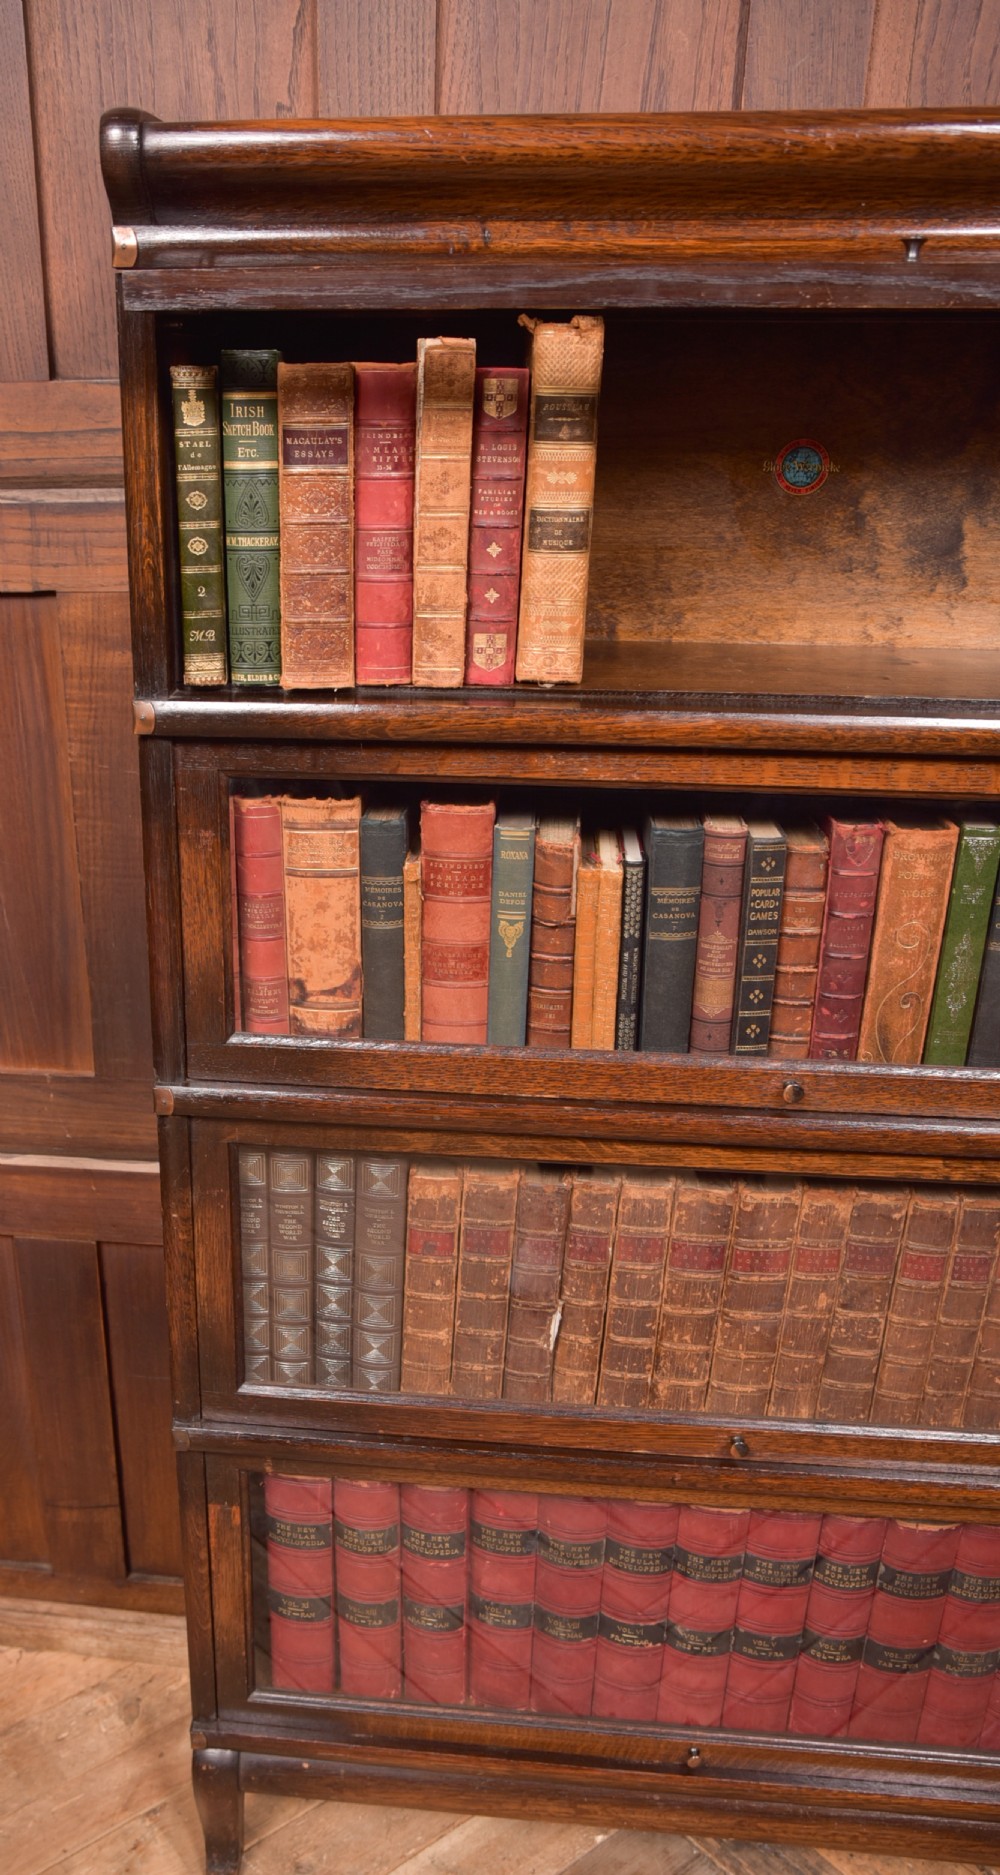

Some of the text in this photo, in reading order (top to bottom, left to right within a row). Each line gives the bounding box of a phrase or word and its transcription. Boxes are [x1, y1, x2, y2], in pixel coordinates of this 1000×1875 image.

[230, 403, 264, 418] IRISH
[286, 437, 343, 445] MACAULAY'S
[492, 443, 518, 451] LOUIS
[238, 447, 260, 458] ETC.
[294, 450, 334, 458] ESSAYS
[542, 539, 574, 549] MUSIQUE
[500, 850, 529, 860] ROXANA
[498, 890, 528, 898] DANIEL
[751, 888, 781, 897] POPULAR
[362, 900, 404, 908] CASANOVA
[499, 898, 526, 906] DEFOE
[749, 911, 779, 921] GAMES
[748, 928, 777, 936] DAWSON
[276, 1522, 291, 1531] THE
[277, 1529, 316, 1540] POPULAR
[344, 1529, 358, 1537] THE
[410, 1530, 425, 1540] THE
[481, 1527, 522, 1540] THE NEW
[344, 1534, 383, 1546] POPULAR
[410, 1537, 450, 1548] POPULAR
[481, 1534, 521, 1546] POPULAR
[549, 1541, 592, 1553] THE NEW
[619, 1547, 636, 1557] THE
[549, 1548, 590, 1559] POPULAR
[619, 1554, 660, 1565] POPULAR
[688, 1554, 704, 1564] THE
[687, 1561, 729, 1573] POPULAR
[756, 1560, 773, 1569] THE
[825, 1563, 869, 1575] THE NEW
[756, 1566, 798, 1577] POPULAR
[825, 1569, 867, 1581] POPULAR
[896, 1573, 913, 1582] THE
[965, 1576, 982, 1585] THE
[895, 1580, 938, 1590] POPULAR
[963, 1583, 1000, 1593] POPULA
